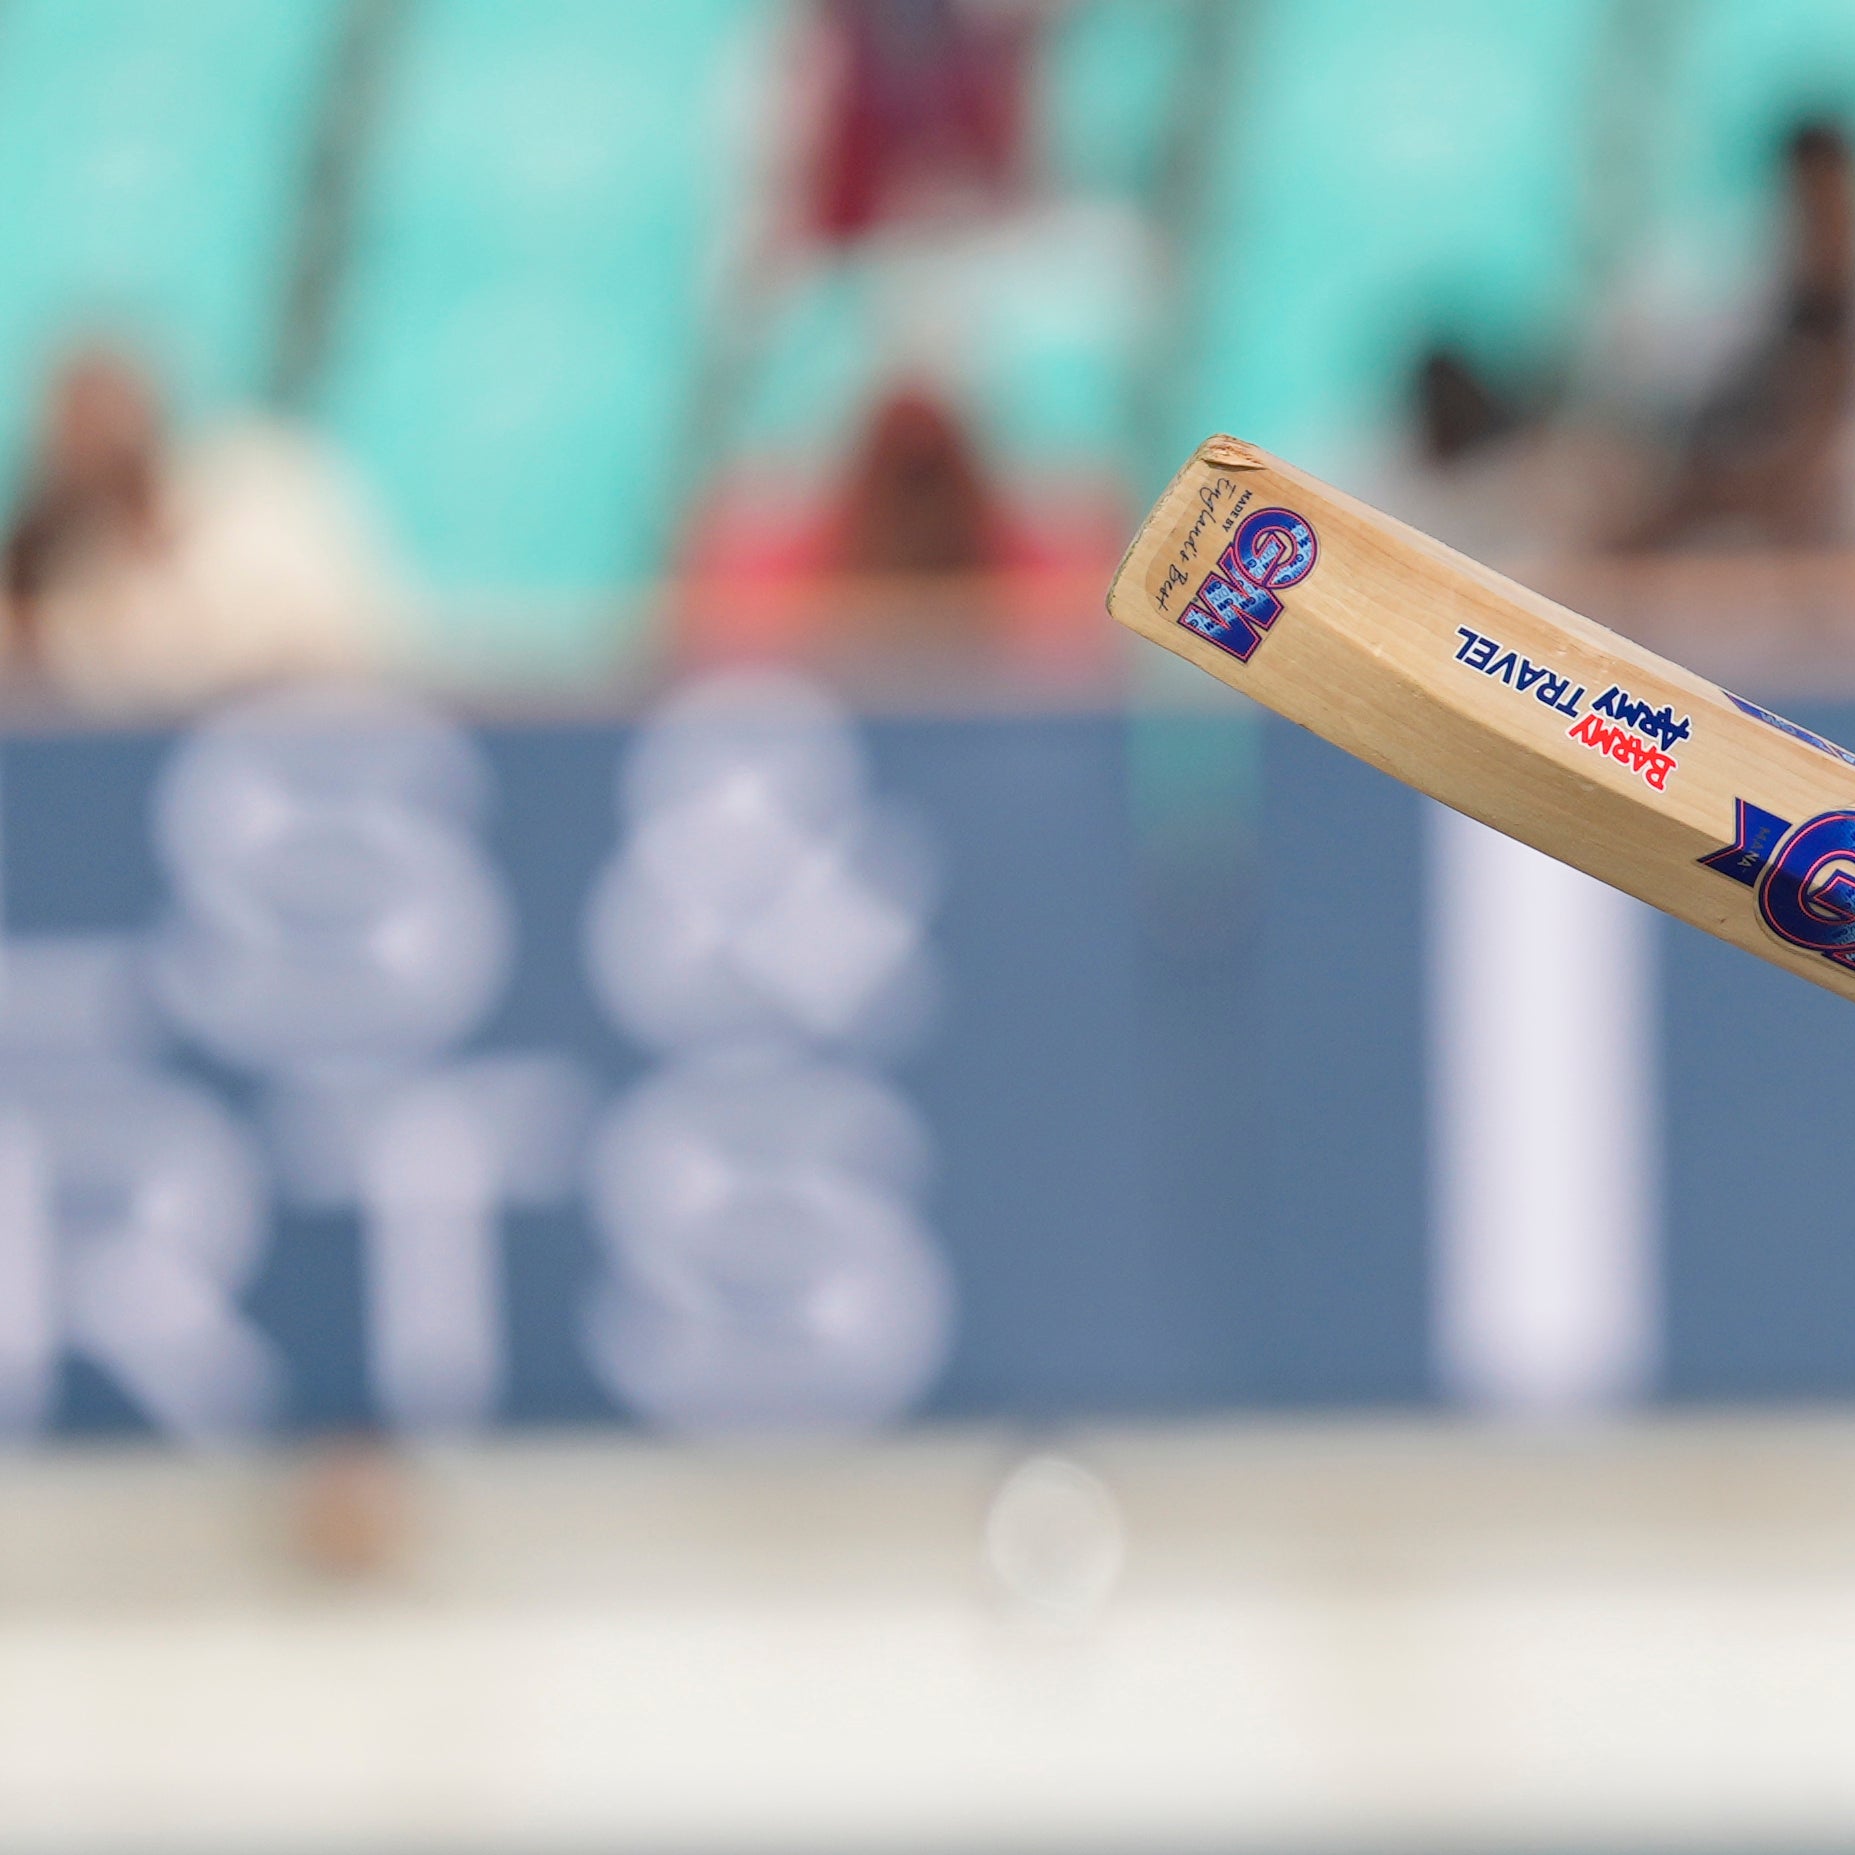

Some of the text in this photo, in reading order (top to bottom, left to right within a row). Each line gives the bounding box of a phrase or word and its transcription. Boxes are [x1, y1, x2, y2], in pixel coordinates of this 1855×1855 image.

[1222, 489, 1253, 533] MADE BY
[1176, 506, 1318, 664] GM
[1455, 626, 1586, 718] TRAVEL
[1568, 713, 1677, 791] BARMY
[1592, 686, 1692, 751] ARMY
